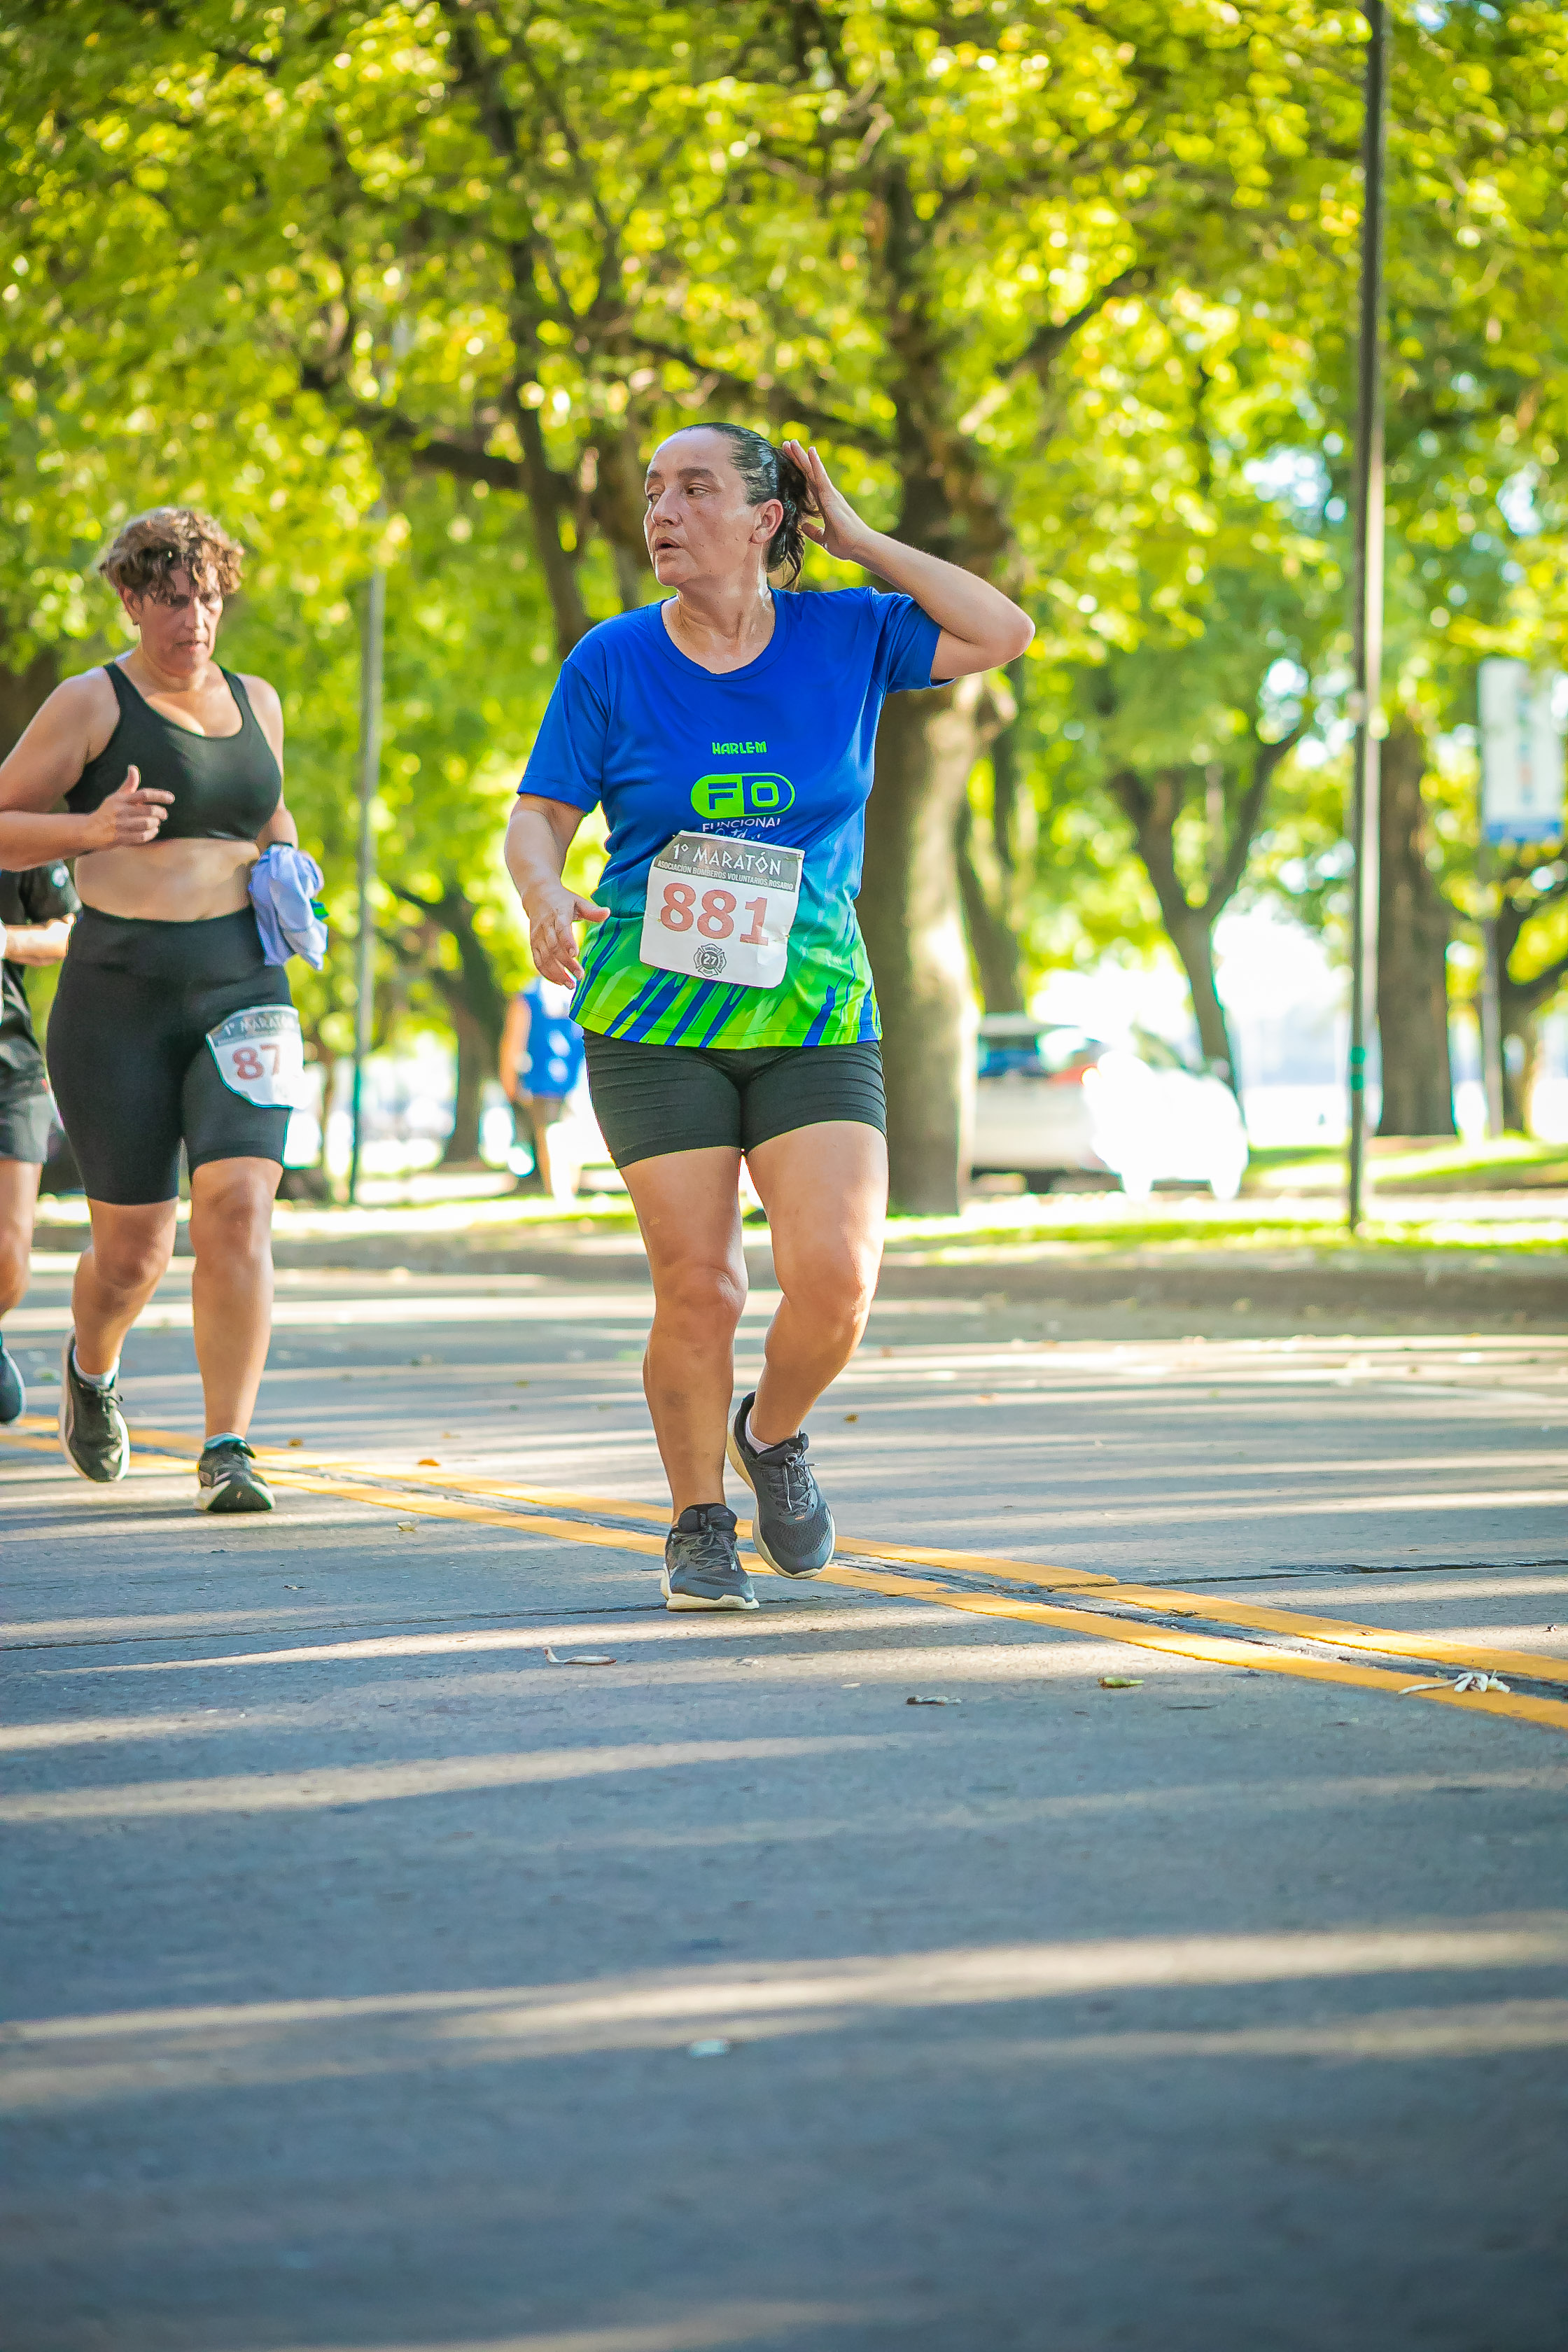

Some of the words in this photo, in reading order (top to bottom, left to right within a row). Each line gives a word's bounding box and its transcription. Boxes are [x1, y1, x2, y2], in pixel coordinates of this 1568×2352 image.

[711, 741, 767, 755] HARLEM
[657, 860, 692, 873] ASOCIACIÓN
[692, 867, 727, 879] BOMBEROS
[727, 872, 768, 886] VOLUNTARIOS
[769, 879, 794, 890] ROSARIO
[692, 846, 782, 876] MARATÓN
[660, 882, 769, 946] 881
[703, 953, 718, 965] 27
